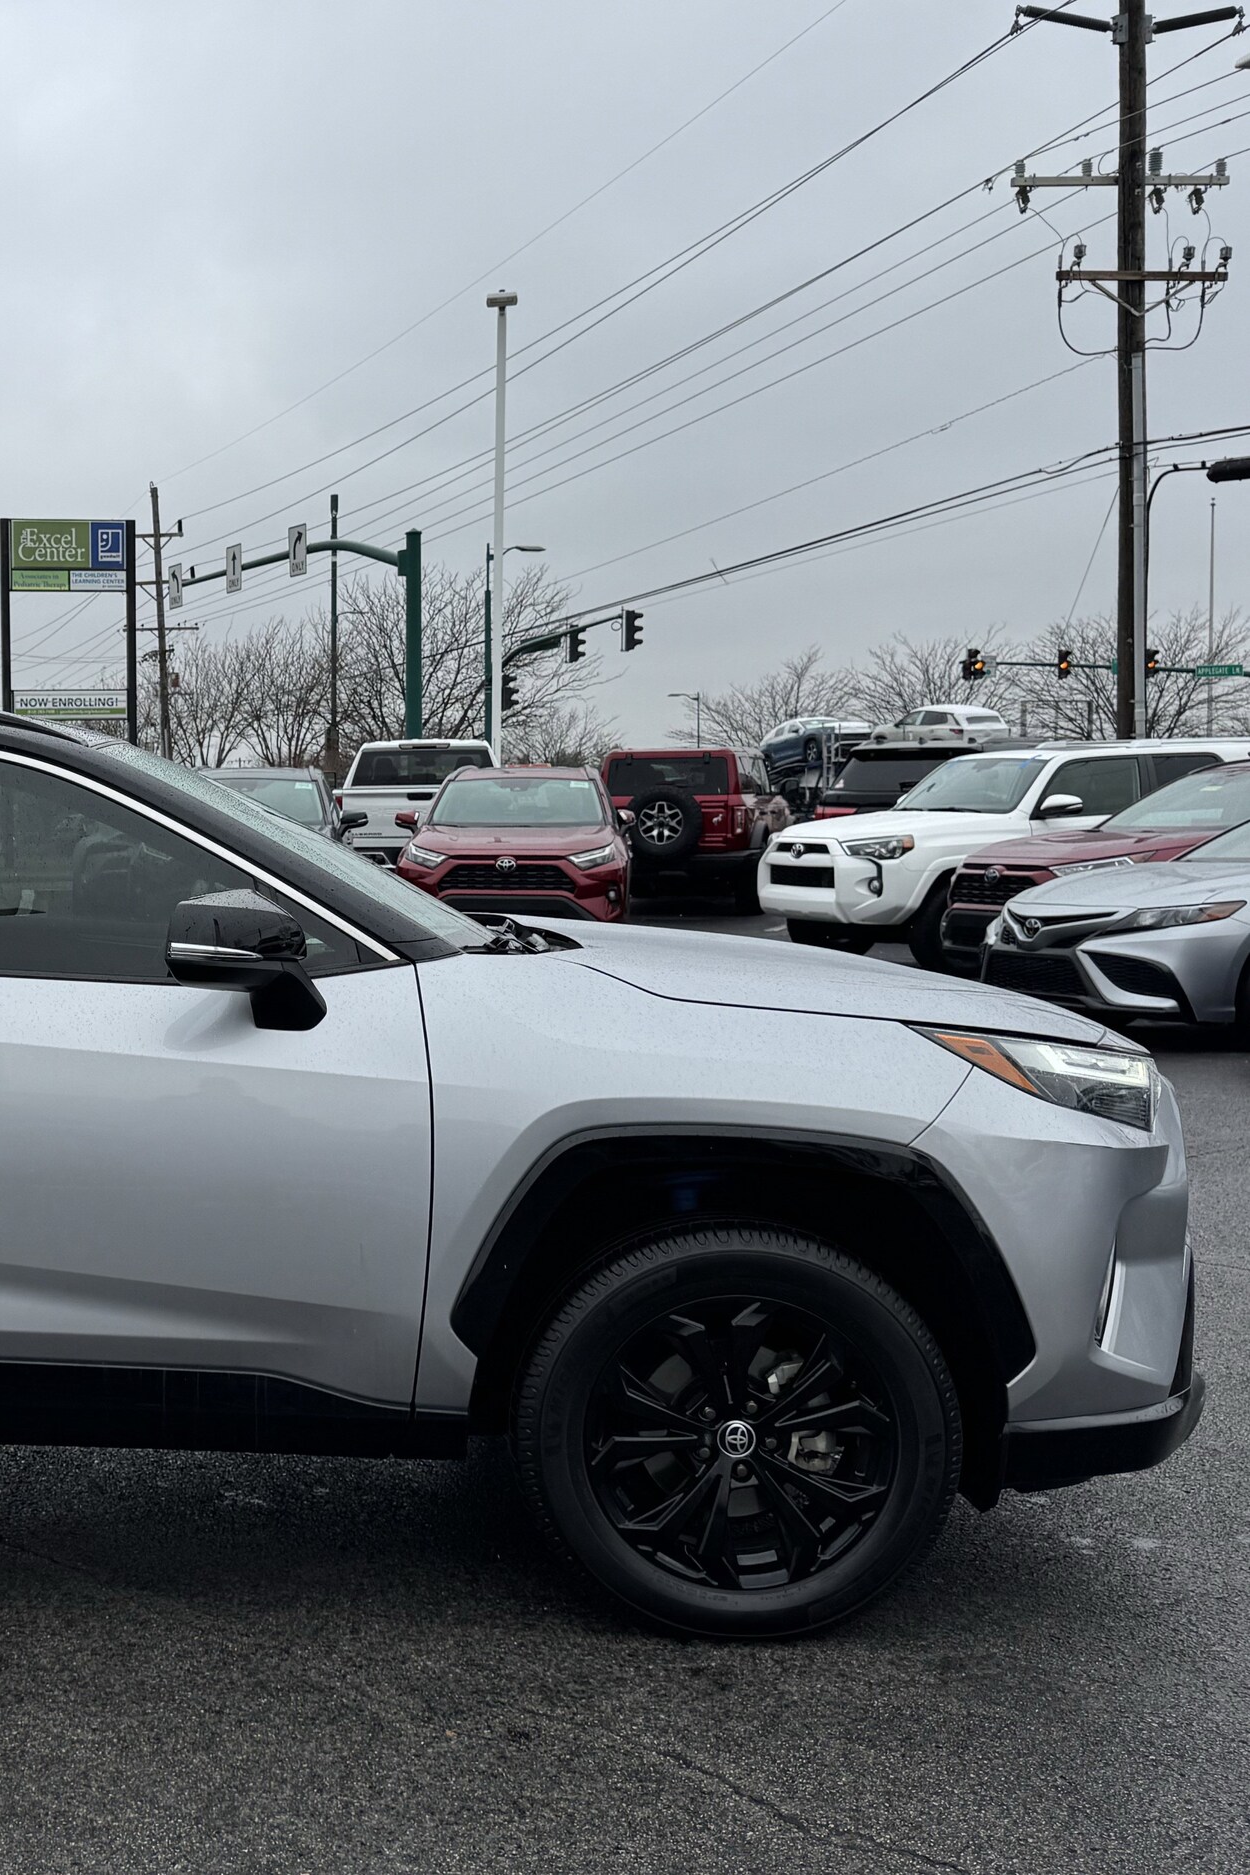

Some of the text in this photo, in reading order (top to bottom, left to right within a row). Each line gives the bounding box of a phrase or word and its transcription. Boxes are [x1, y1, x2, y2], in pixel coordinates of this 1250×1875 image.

[25, 528, 77, 547] Excel
[18, 542, 86, 561] Center
[19, 697, 119, 708] NOW ENROLLING!
